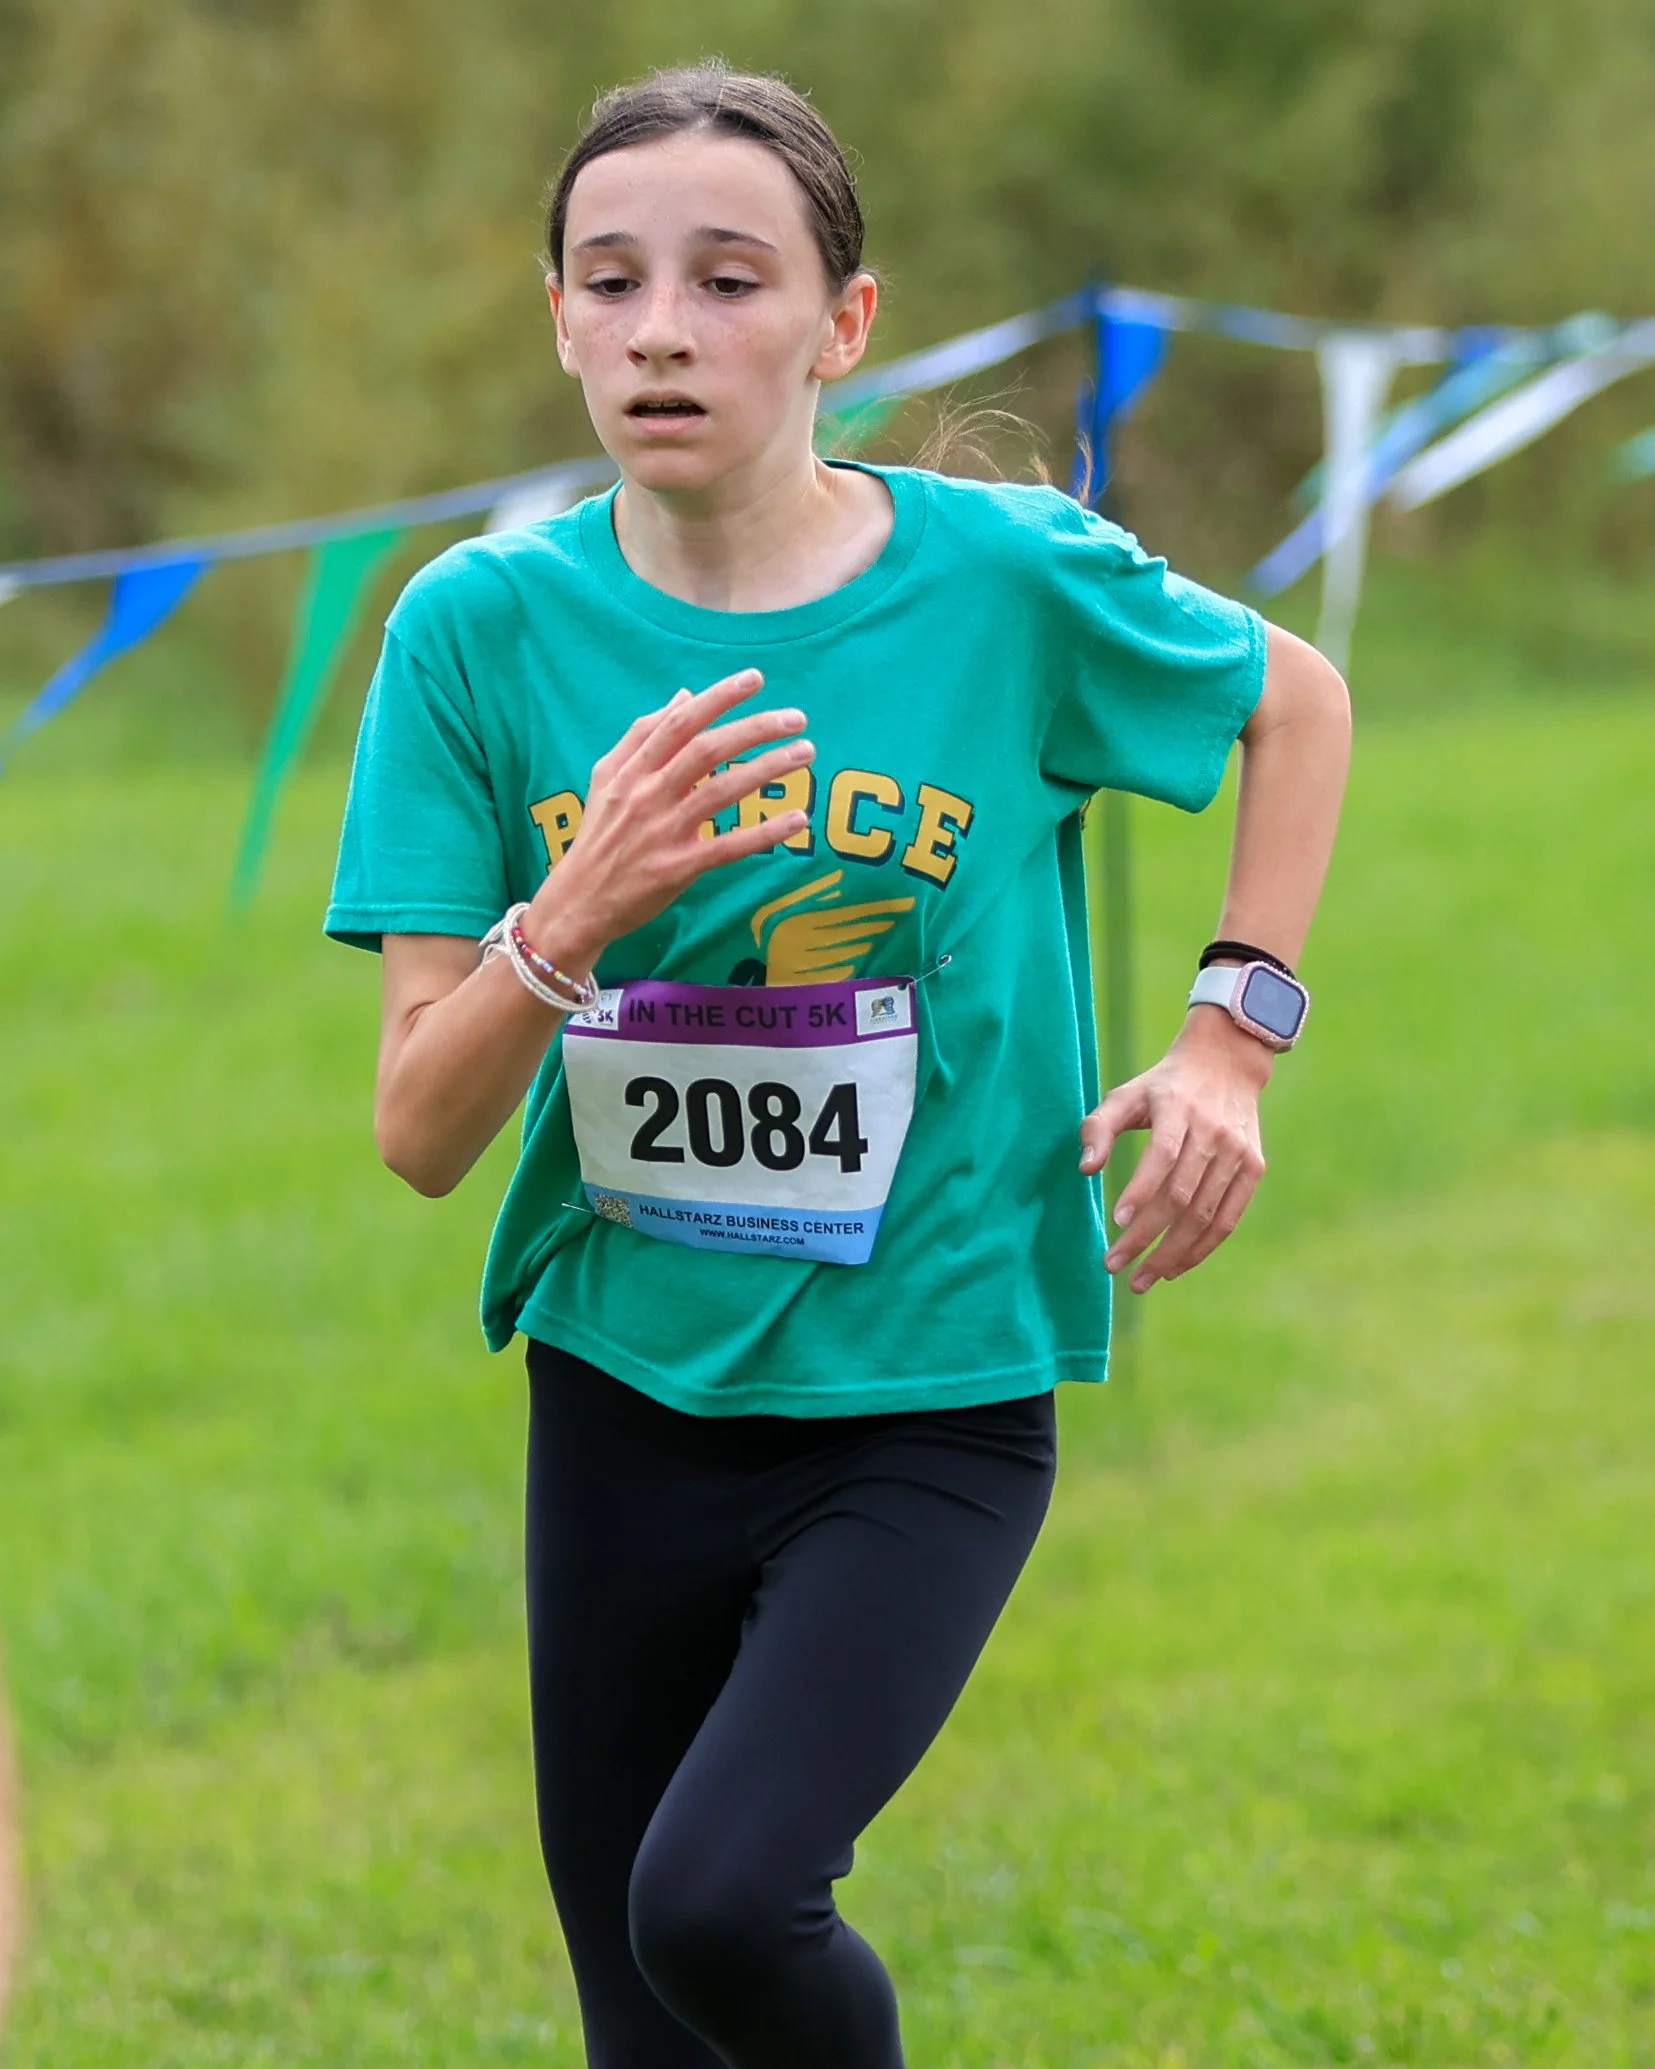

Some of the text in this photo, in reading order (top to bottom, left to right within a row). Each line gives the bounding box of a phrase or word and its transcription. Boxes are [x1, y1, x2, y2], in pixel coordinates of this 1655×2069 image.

[527, 760, 974, 891] PRCE
[629, 998, 846, 1029] IN THE CUT 5K
[624, 1076, 868, 1173] 2084
[639, 1204, 864, 1234] HALLSTARZ BUSINESS CENTER
[699, 1229, 805, 1245] WWW.HALLSTARZ.COM
